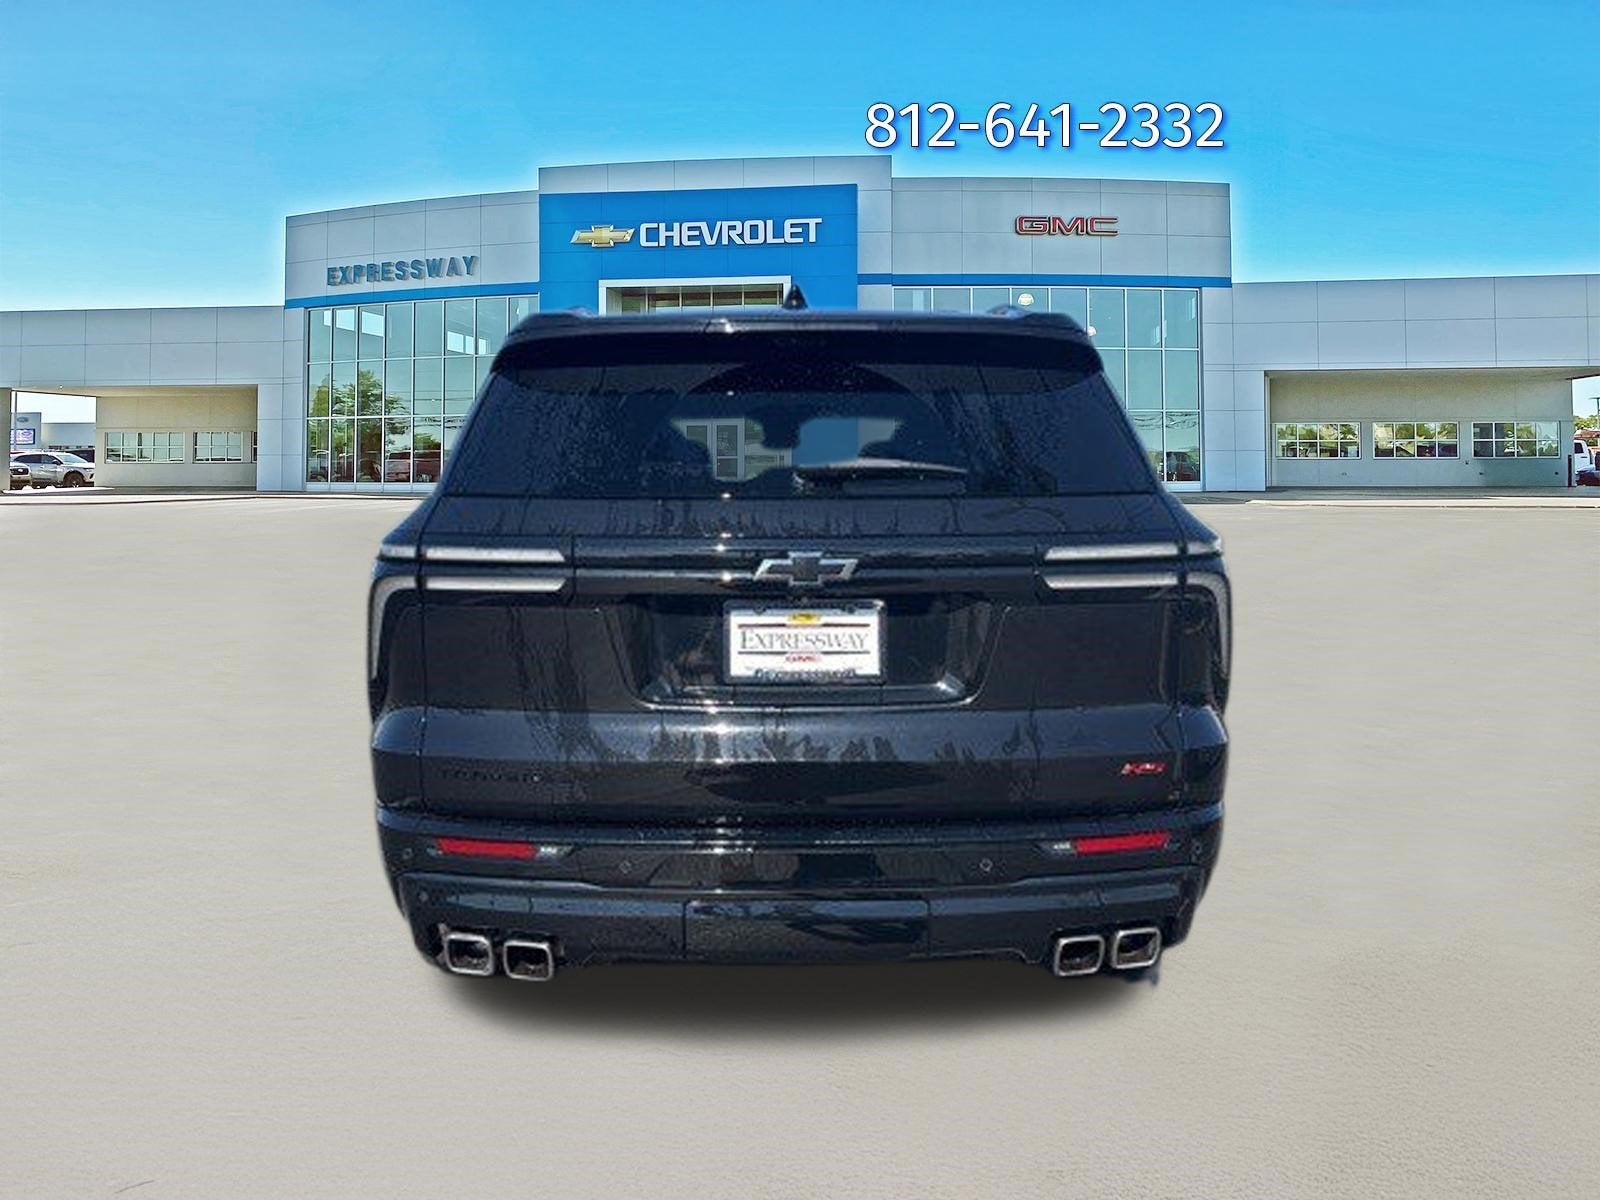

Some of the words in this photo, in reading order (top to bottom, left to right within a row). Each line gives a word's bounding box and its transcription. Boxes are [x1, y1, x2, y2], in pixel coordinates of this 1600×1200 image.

[639, 217, 823, 247] CHEVROLET
[1015, 215, 1120, 236] GMC
[327, 255, 479, 286] EXPRESSWAY
